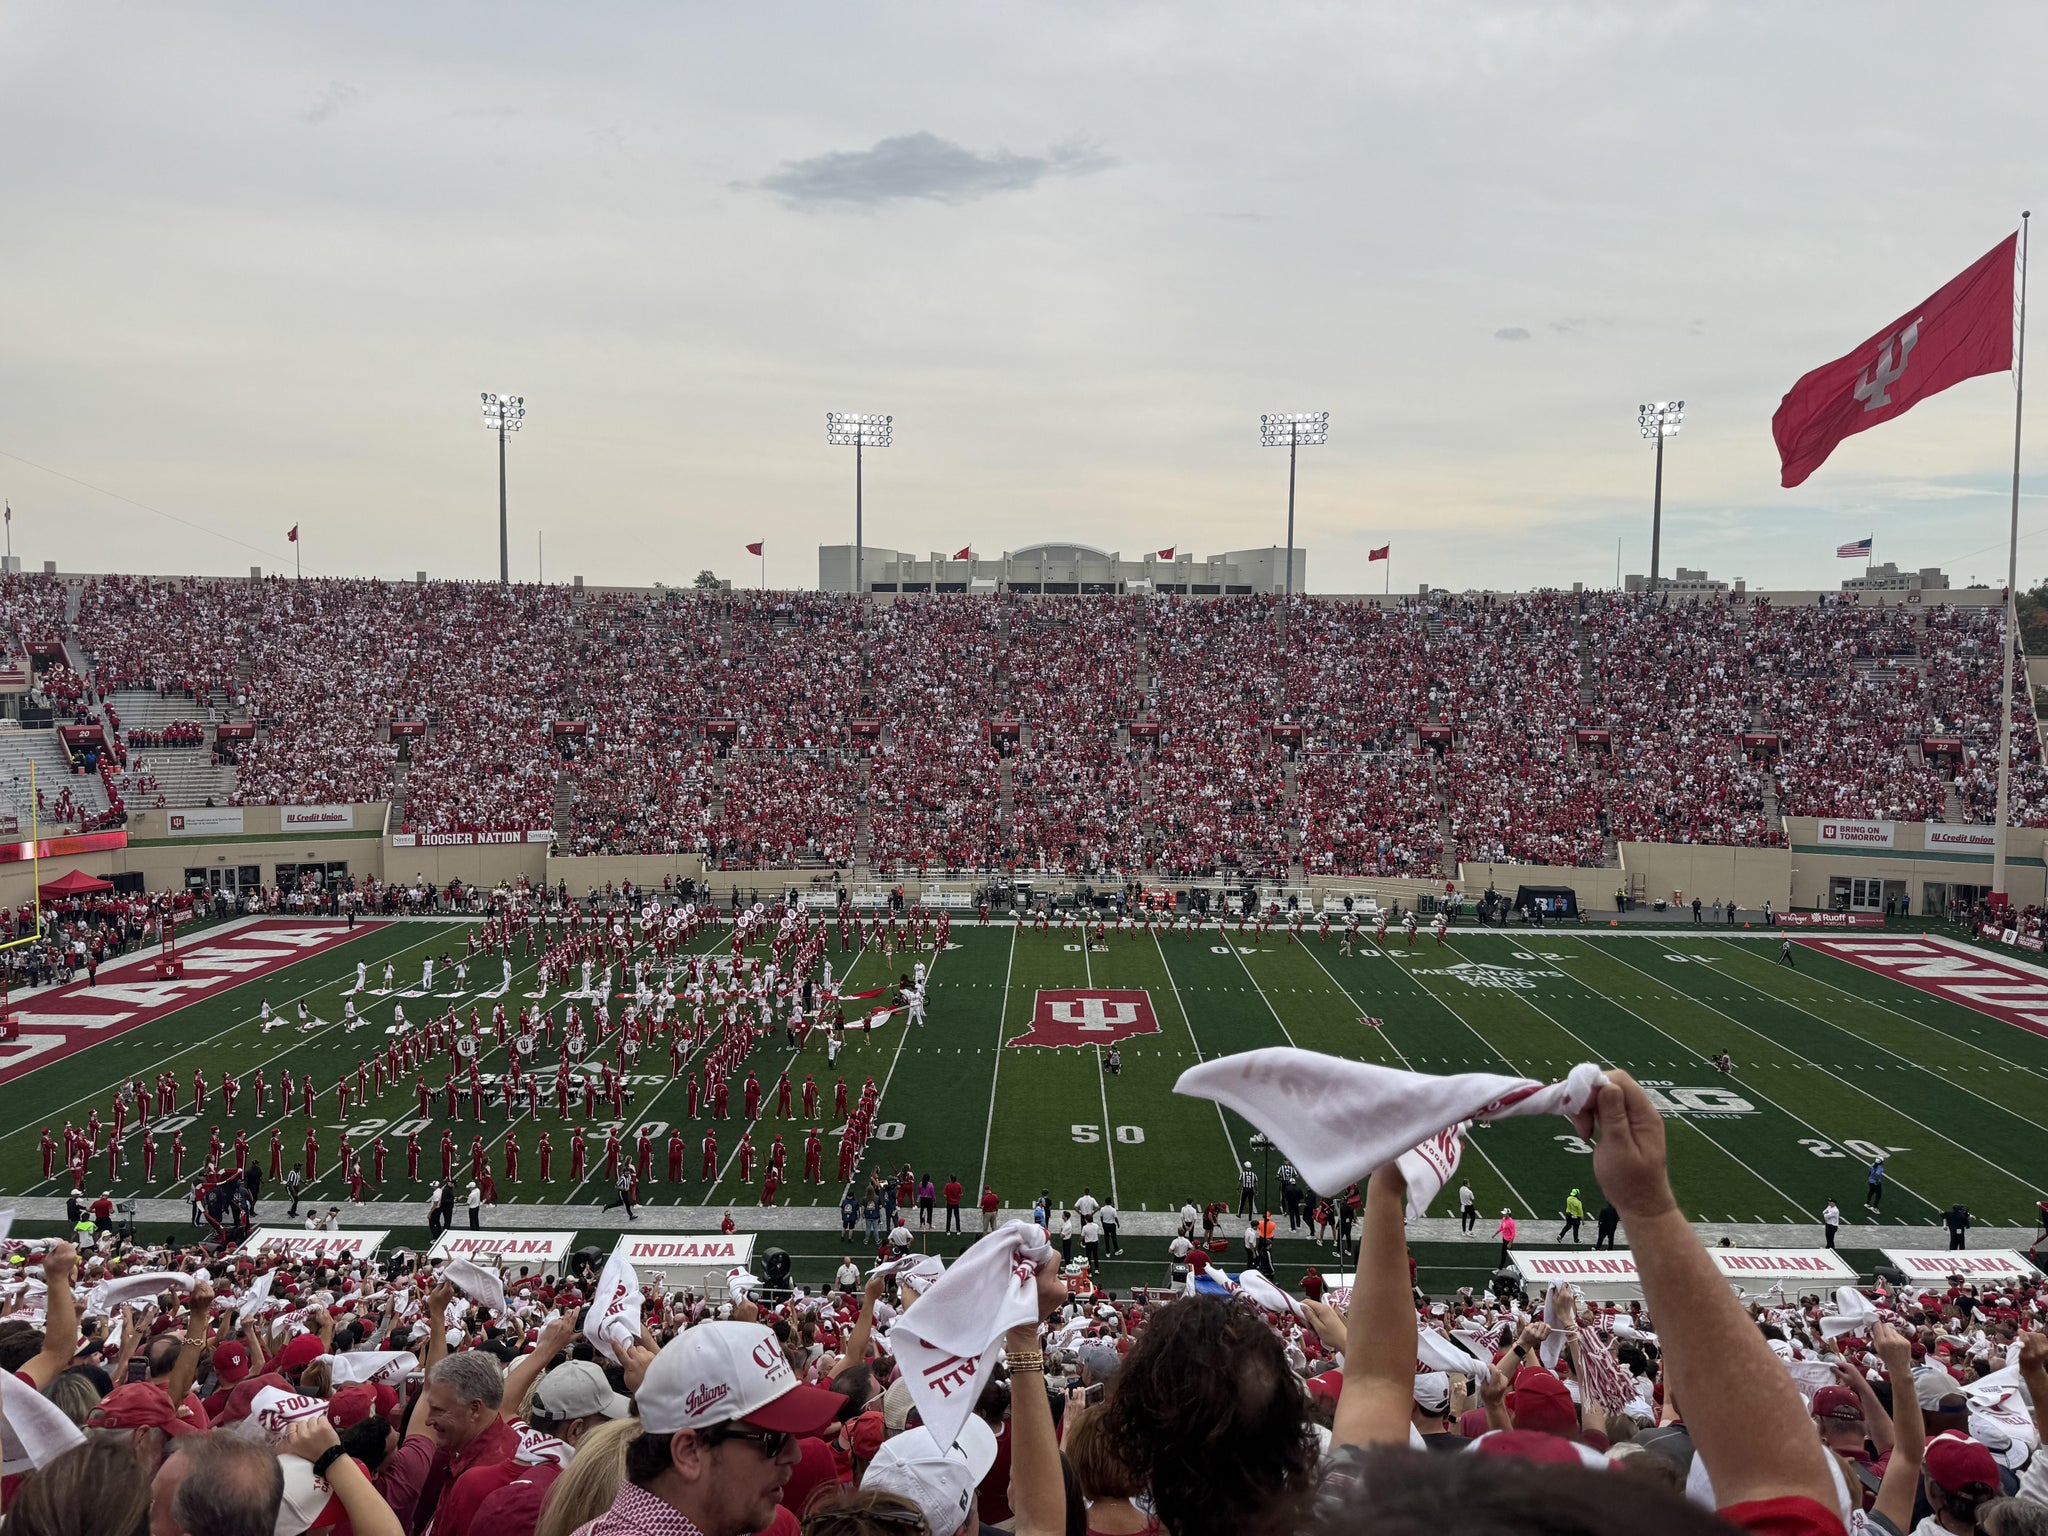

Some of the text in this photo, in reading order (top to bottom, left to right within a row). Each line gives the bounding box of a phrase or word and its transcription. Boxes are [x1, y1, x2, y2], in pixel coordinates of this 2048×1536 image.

[79, 730, 90, 738] 20
[287, 812, 343, 822] IU Credit Union
[1840, 826, 1865, 834] BRING
[1840, 833, 1888, 842] TOMORROW
[422, 831, 520, 846] HOOSIER NATION
[1932, 832, 1994, 844] IU Credit Union
[1411, 968, 1566, 978] MERCHANTS
[1456, 975, 1532, 984] BANK
[346, 1118, 434, 1137] 20
[586, 1121, 670, 1140] 30
[1071, 1124, 1146, 1144] 50
[1554, 1135, 1594, 1154] 3
[1796, 1138, 1892, 1158] 20
[260, 1237, 364, 1252] INDIANA
[451, 1238, 552, 1253] INDIANA
[630, 1243, 736, 1257] INDIANA
[1529, 1259, 1639, 1274] INDIANA
[1718, 1255, 1836, 1270] INDIANA
[1906, 1258, 2022, 1272] INDIANA
[684, 1384, 731, 1418] Indiana
